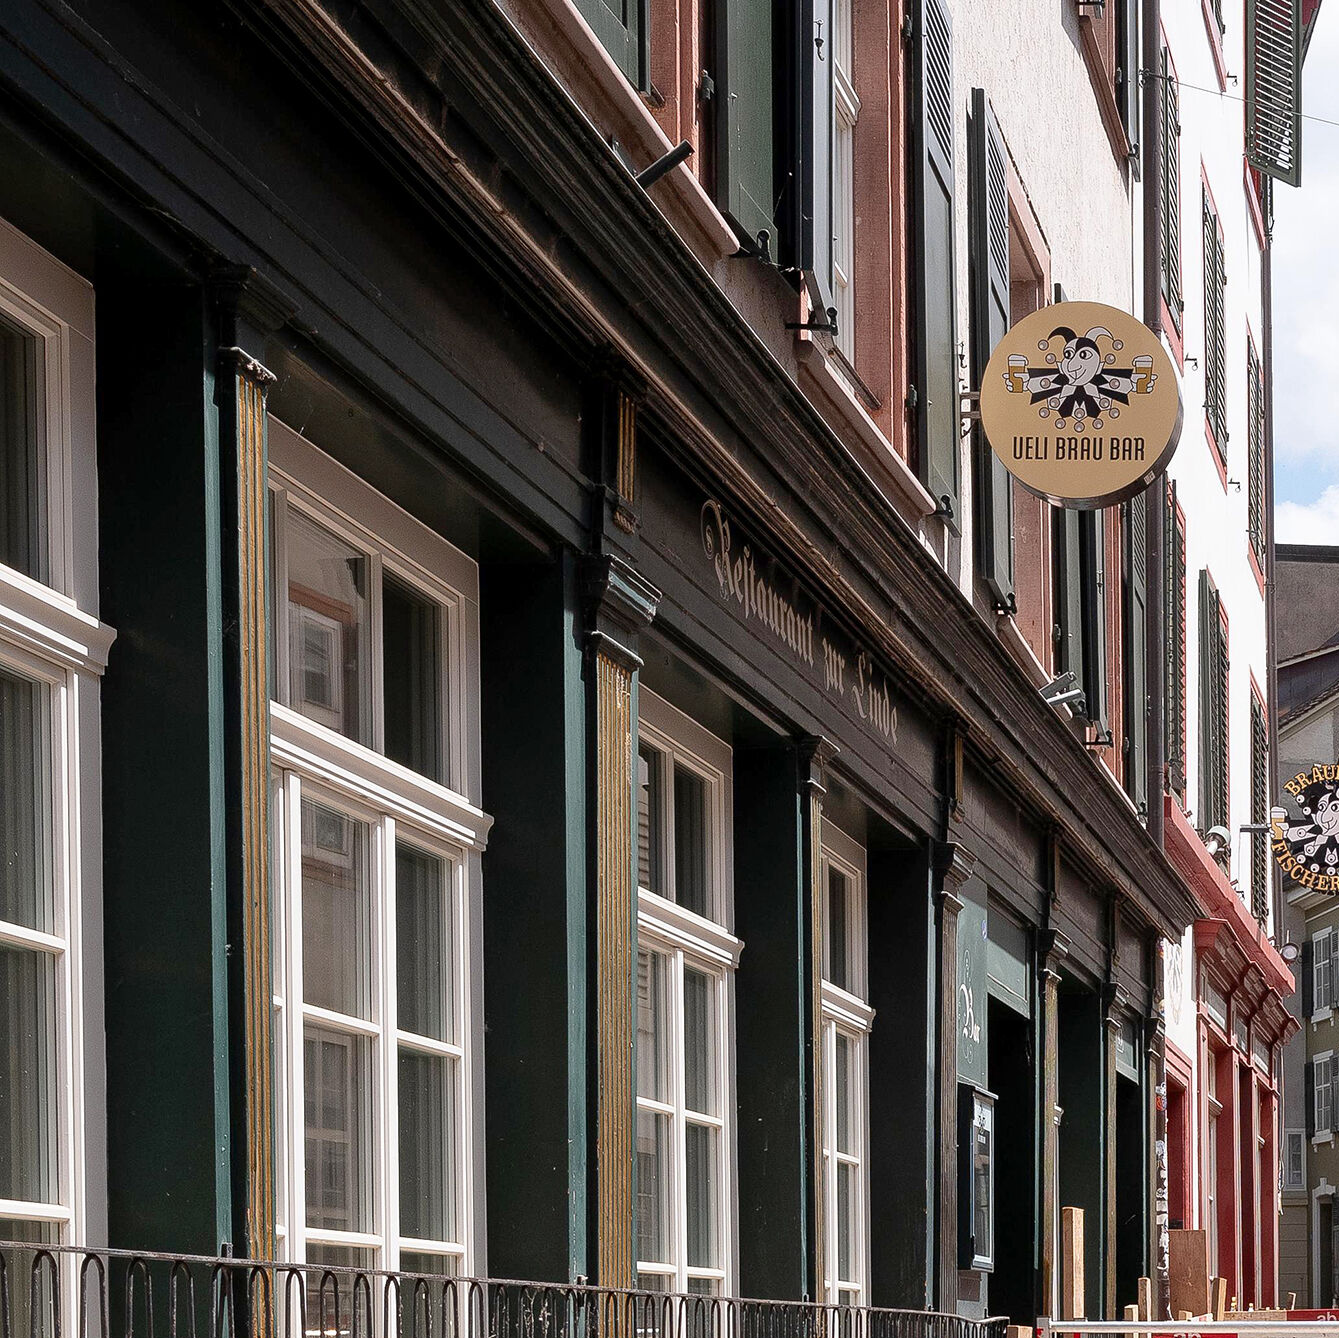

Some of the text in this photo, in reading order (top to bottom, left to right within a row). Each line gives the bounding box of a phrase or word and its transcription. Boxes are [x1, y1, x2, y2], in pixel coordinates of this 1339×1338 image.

[1013, 436, 1145, 461] UELI BRAU BAR
[852, 652, 898, 745] Linde
